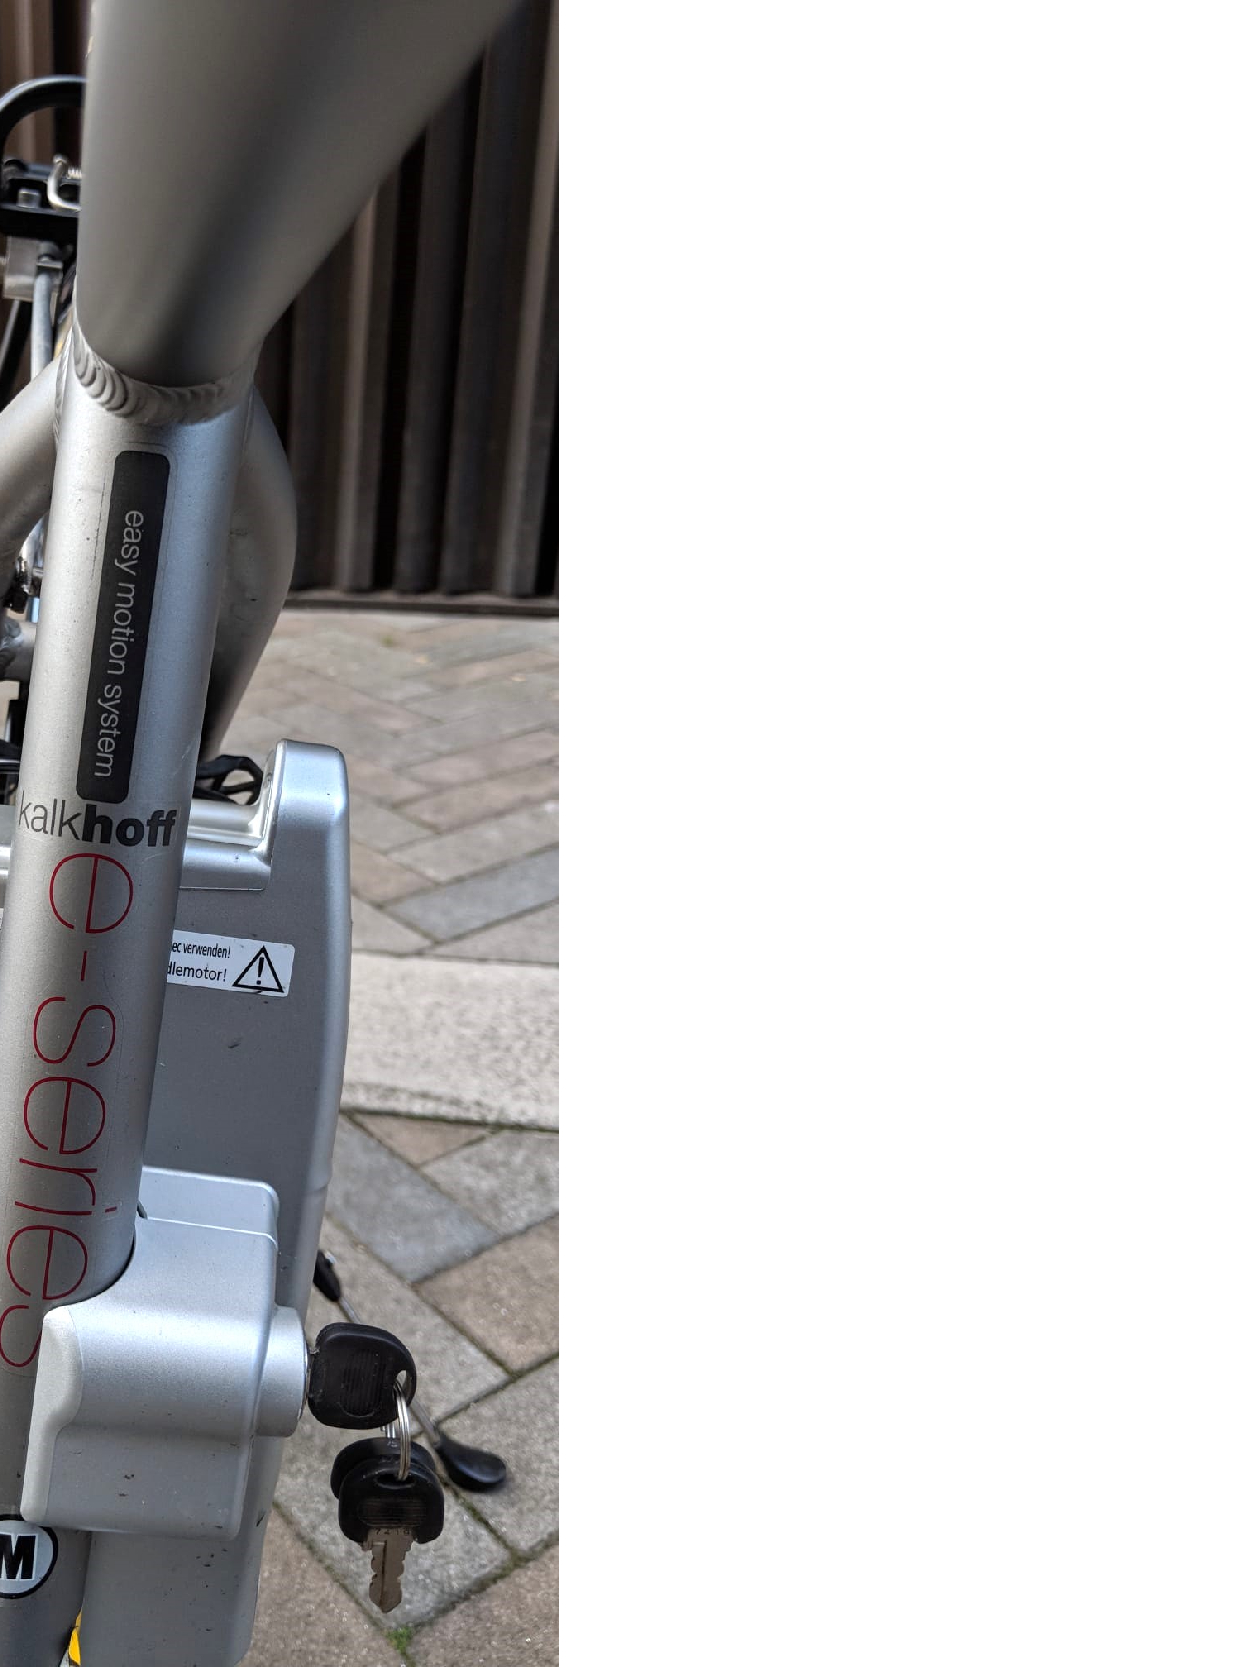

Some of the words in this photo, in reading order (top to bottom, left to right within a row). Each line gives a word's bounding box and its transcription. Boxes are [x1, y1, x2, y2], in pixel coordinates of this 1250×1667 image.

[114, 510, 145, 576] easy
[106, 582, 136, 676] motion
[94, 684, 122, 777] system
[18, 790, 178, 848] kalkhoff
[183, 943, 231, 959] verwenden!
